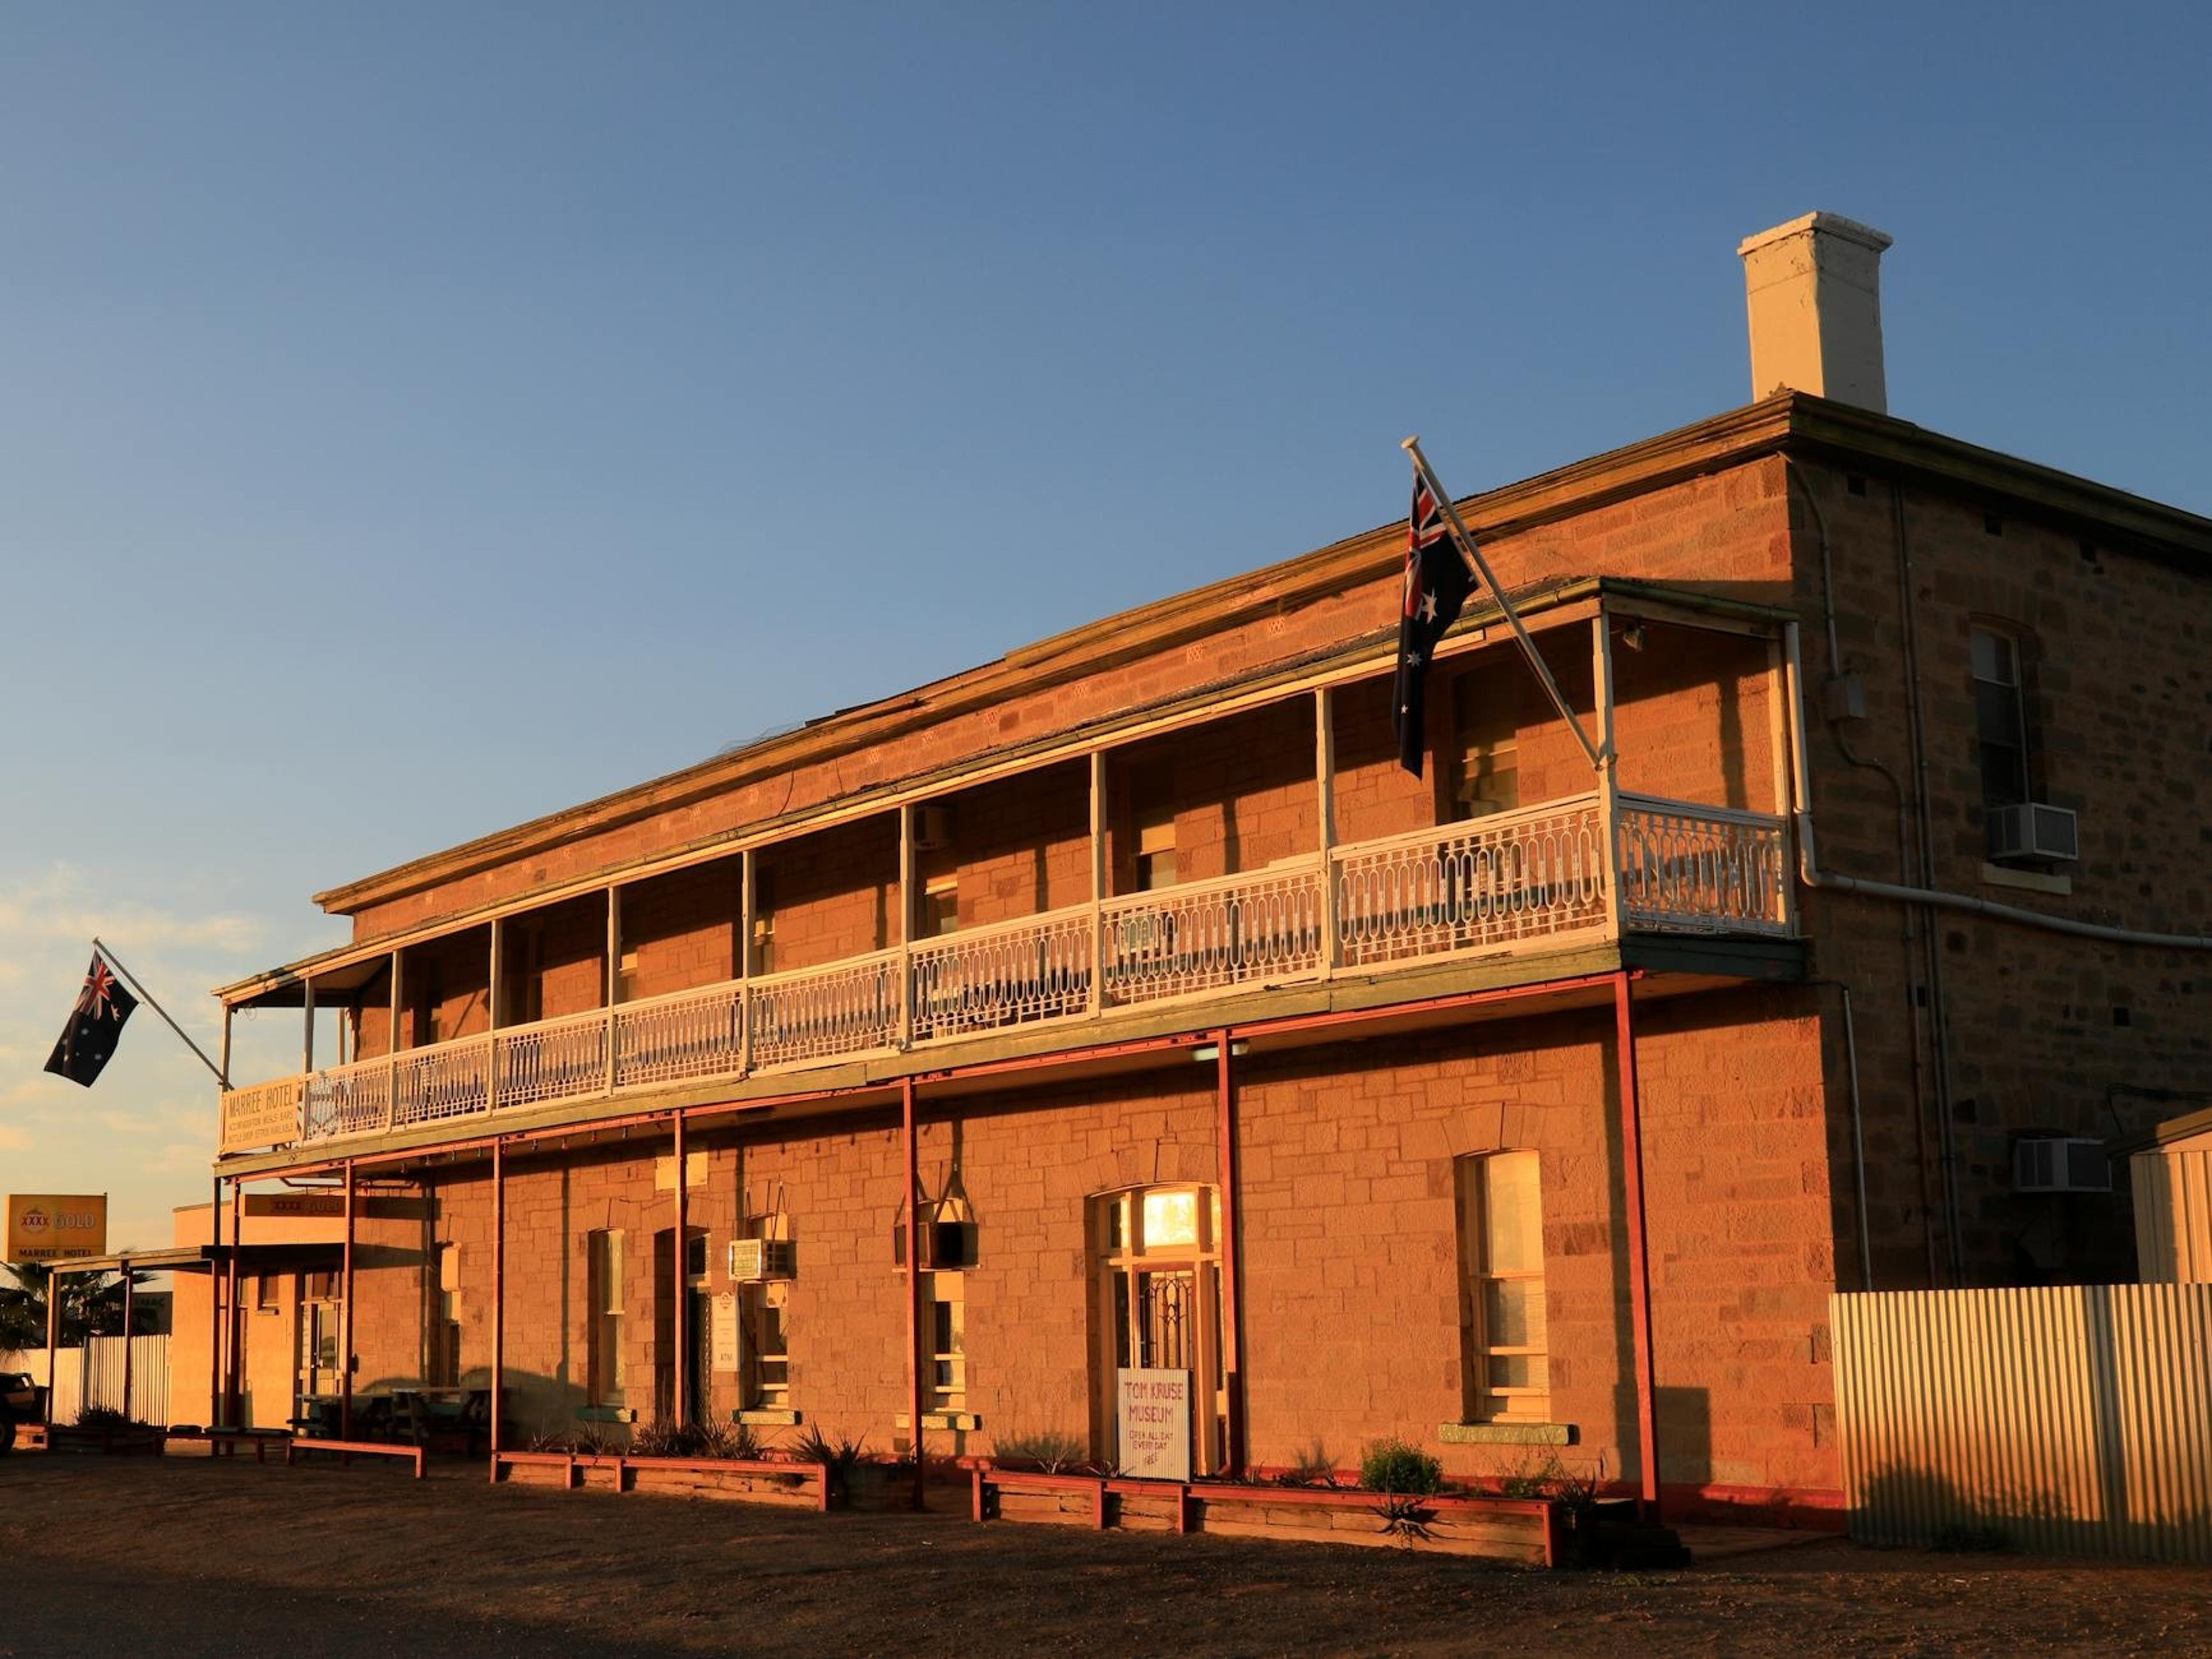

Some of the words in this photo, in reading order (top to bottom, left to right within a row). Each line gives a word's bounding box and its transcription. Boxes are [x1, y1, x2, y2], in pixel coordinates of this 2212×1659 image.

[229, 1090, 262, 1118] MARREE
[266, 1083, 294, 1111] HOTEL
[21, 1215, 49, 1226] XXXX
[54, 1213, 95, 1228] GOLD
[18, 1248, 57, 1257] MARREE
[64, 1249, 92, 1257] HOTEL
[1124, 1381, 1146, 1399] TOM
[1152, 1382, 1183, 1400] KRUSE
[1128, 1405, 1173, 1424] MUSEUM
[1129, 1430, 1145, 1440] OPEN
[1149, 1431, 1158, 1440] ALL
[1161, 1430, 1173, 1441] DAY
